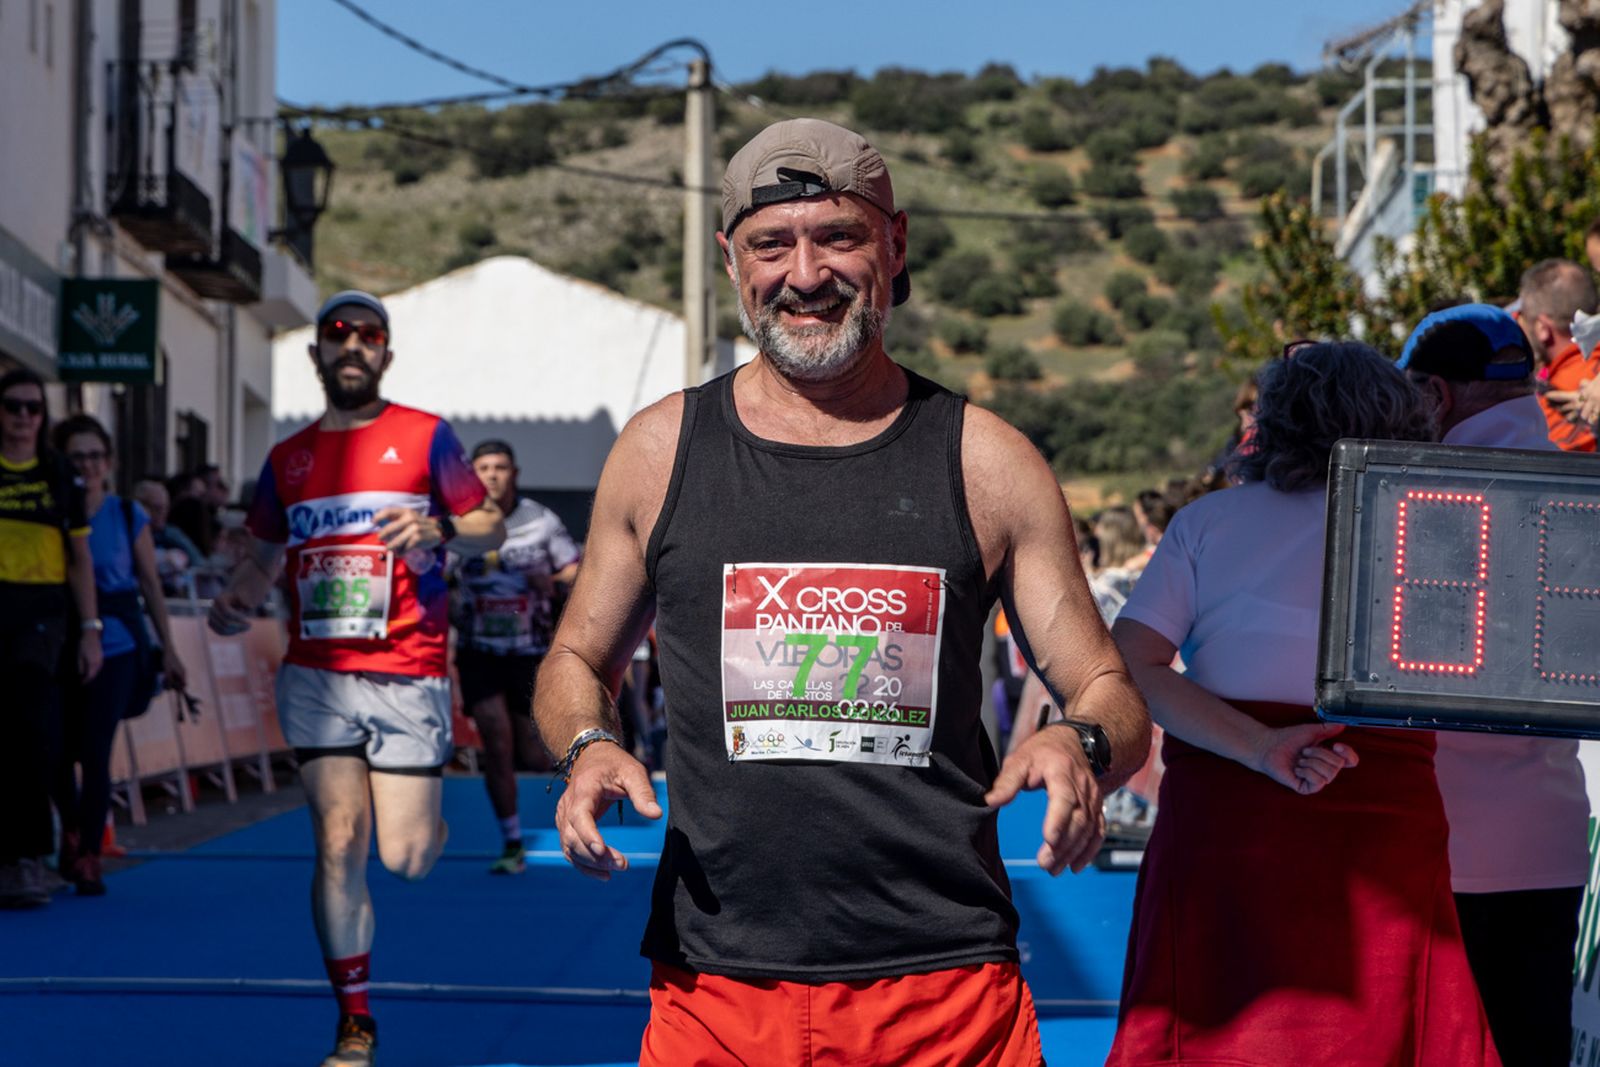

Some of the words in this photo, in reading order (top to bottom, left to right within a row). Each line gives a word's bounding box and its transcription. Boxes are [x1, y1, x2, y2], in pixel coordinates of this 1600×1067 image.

[323, 555, 374, 572] CROSS
[1391, 490, 1491, 673] 0
[313, 577, 369, 609] 495
[756, 576, 789, 610] X
[796, 587, 907, 614] CROSS
[755, 613, 881, 636] PANTANO
[886, 621, 905, 632] DEL
[785, 633, 879, 700] 77
[753, 680, 774, 690] LAS
[778, 680, 833, 690] CALLAS
[768, 690, 782, 700] DE
[786, 690, 833, 701] MRTOS
[873, 675, 902, 697] 20
[730, 703, 770, 718] JUAN
[774, 703, 842, 718] CARLOS
